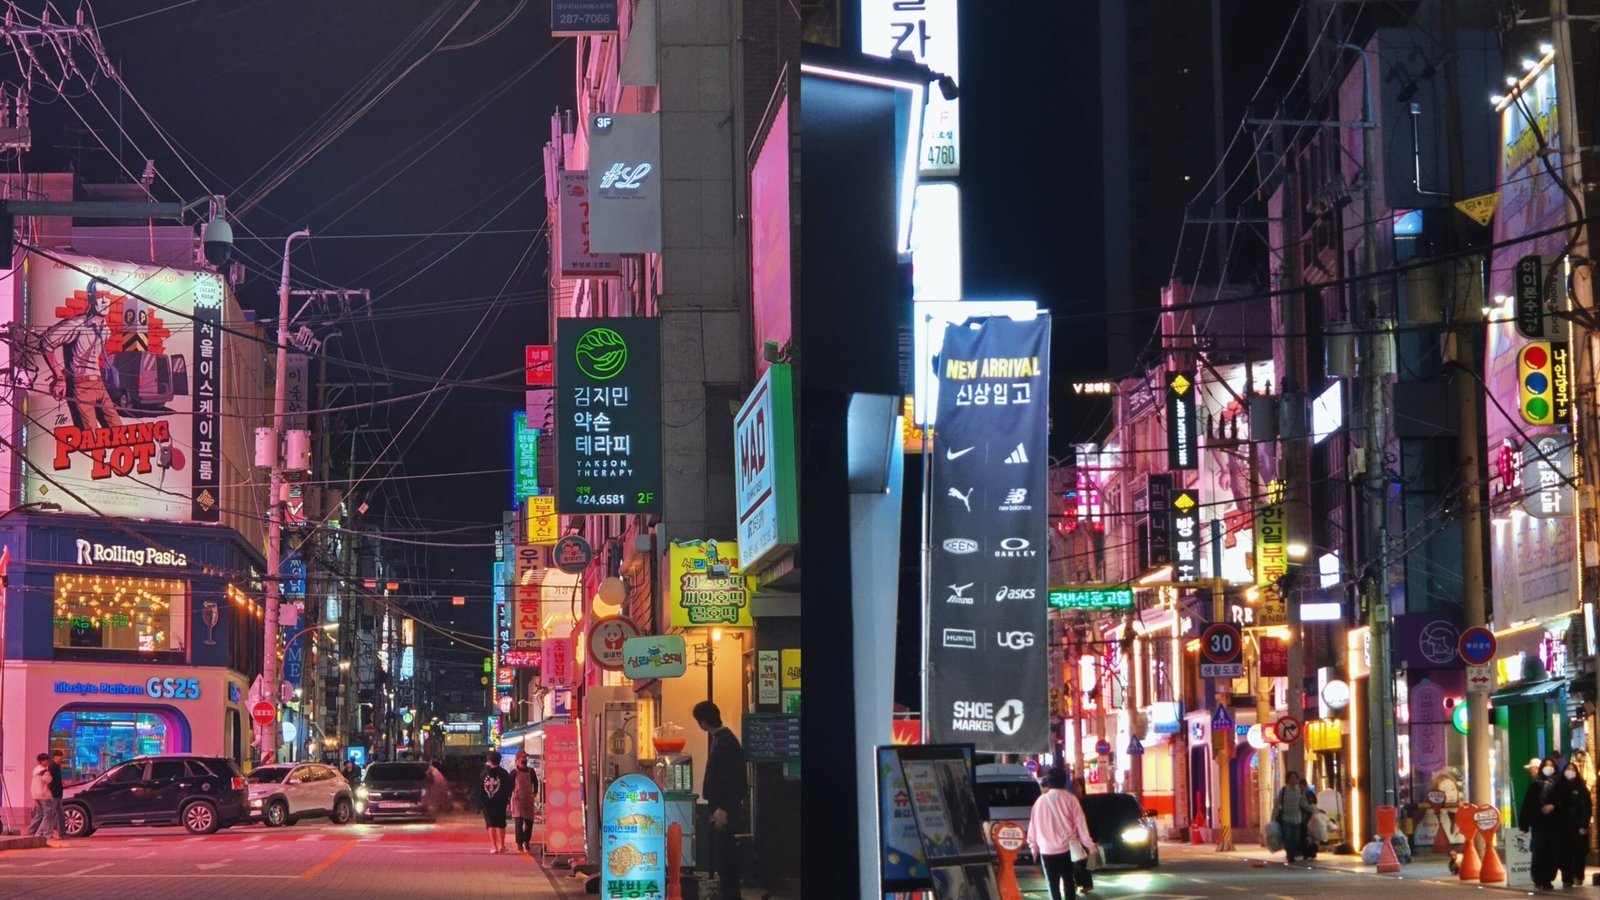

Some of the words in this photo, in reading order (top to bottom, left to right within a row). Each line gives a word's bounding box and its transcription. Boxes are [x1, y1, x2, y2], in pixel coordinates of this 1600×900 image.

[597, 117, 611, 128] 3F
[946, 358, 978, 379] NEW
[981, 356, 1041, 378] ARRIVAL
[199, 319, 214, 480] 서울이스케이프룸
[574, 386, 629, 407] 김지민
[956, 382, 1031, 406] 신상입고
[54, 413, 69, 426] The
[574, 411, 612, 432] 약손
[53, 420, 170, 471] PARKING
[575, 435, 630, 456] 테라피
[740, 406, 767, 492] MAD
[91, 443, 156, 480] LOT
[576, 469, 633, 477] THERAPY
[576, 494, 625, 505] 424.6581
[637, 493, 654, 503] 2F
[535, 505, 552, 538] 부동산
[1261, 508, 1283, 544] 한일
[93, 543, 145, 566] Rolling
[145, 547, 188, 566] Pasta
[945, 541, 977, 551] KEEN
[1007, 588, 1036, 600] asics
[946, 634, 973, 643] HUNTER
[997, 631, 1036, 650] UGG
[1210, 634, 1232, 652] 30
[1203, 665, 1241, 675] 생활도로
[54, 681, 98, 695] Lifestyle
[100, 682, 144, 695] Platform
[146, 677, 201, 699] GS25
[953, 701, 993, 719] SHOE
[952, 719, 994, 732] MARKER
